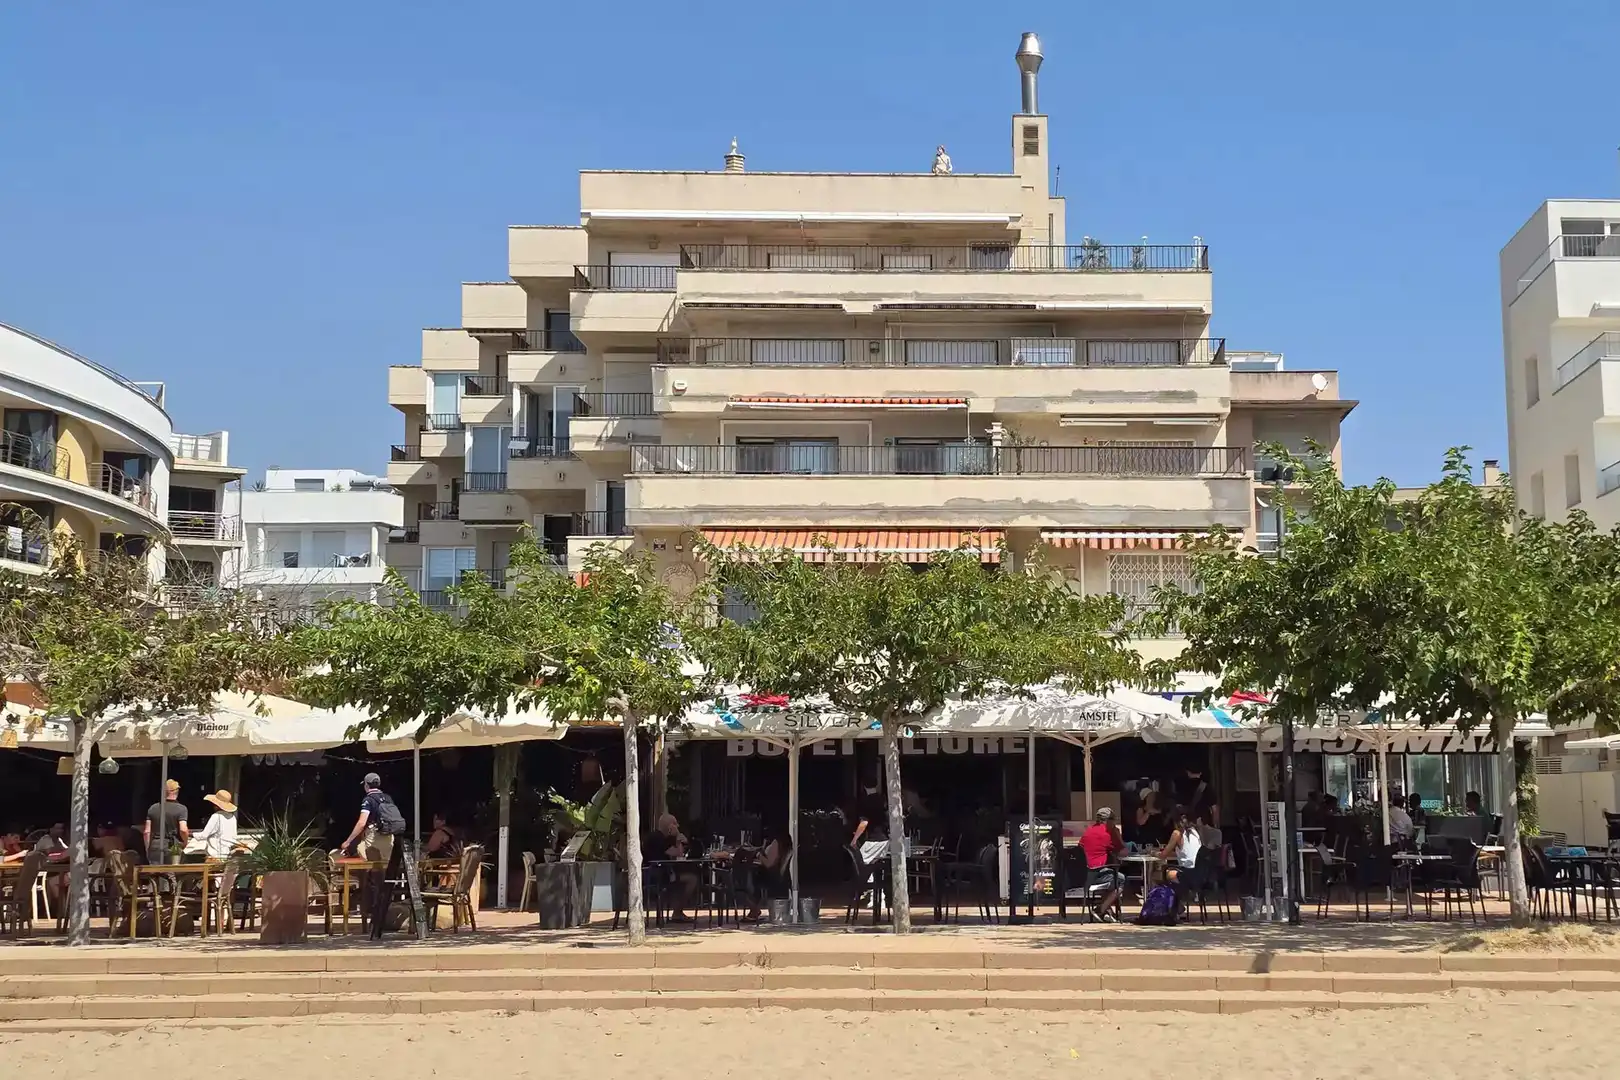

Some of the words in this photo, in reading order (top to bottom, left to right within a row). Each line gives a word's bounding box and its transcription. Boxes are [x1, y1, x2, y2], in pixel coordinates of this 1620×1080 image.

[784, 714, 861, 727] SILVER
[1079, 711, 1119, 721] AMSTEL
[727, 738, 854, 756] BUET
